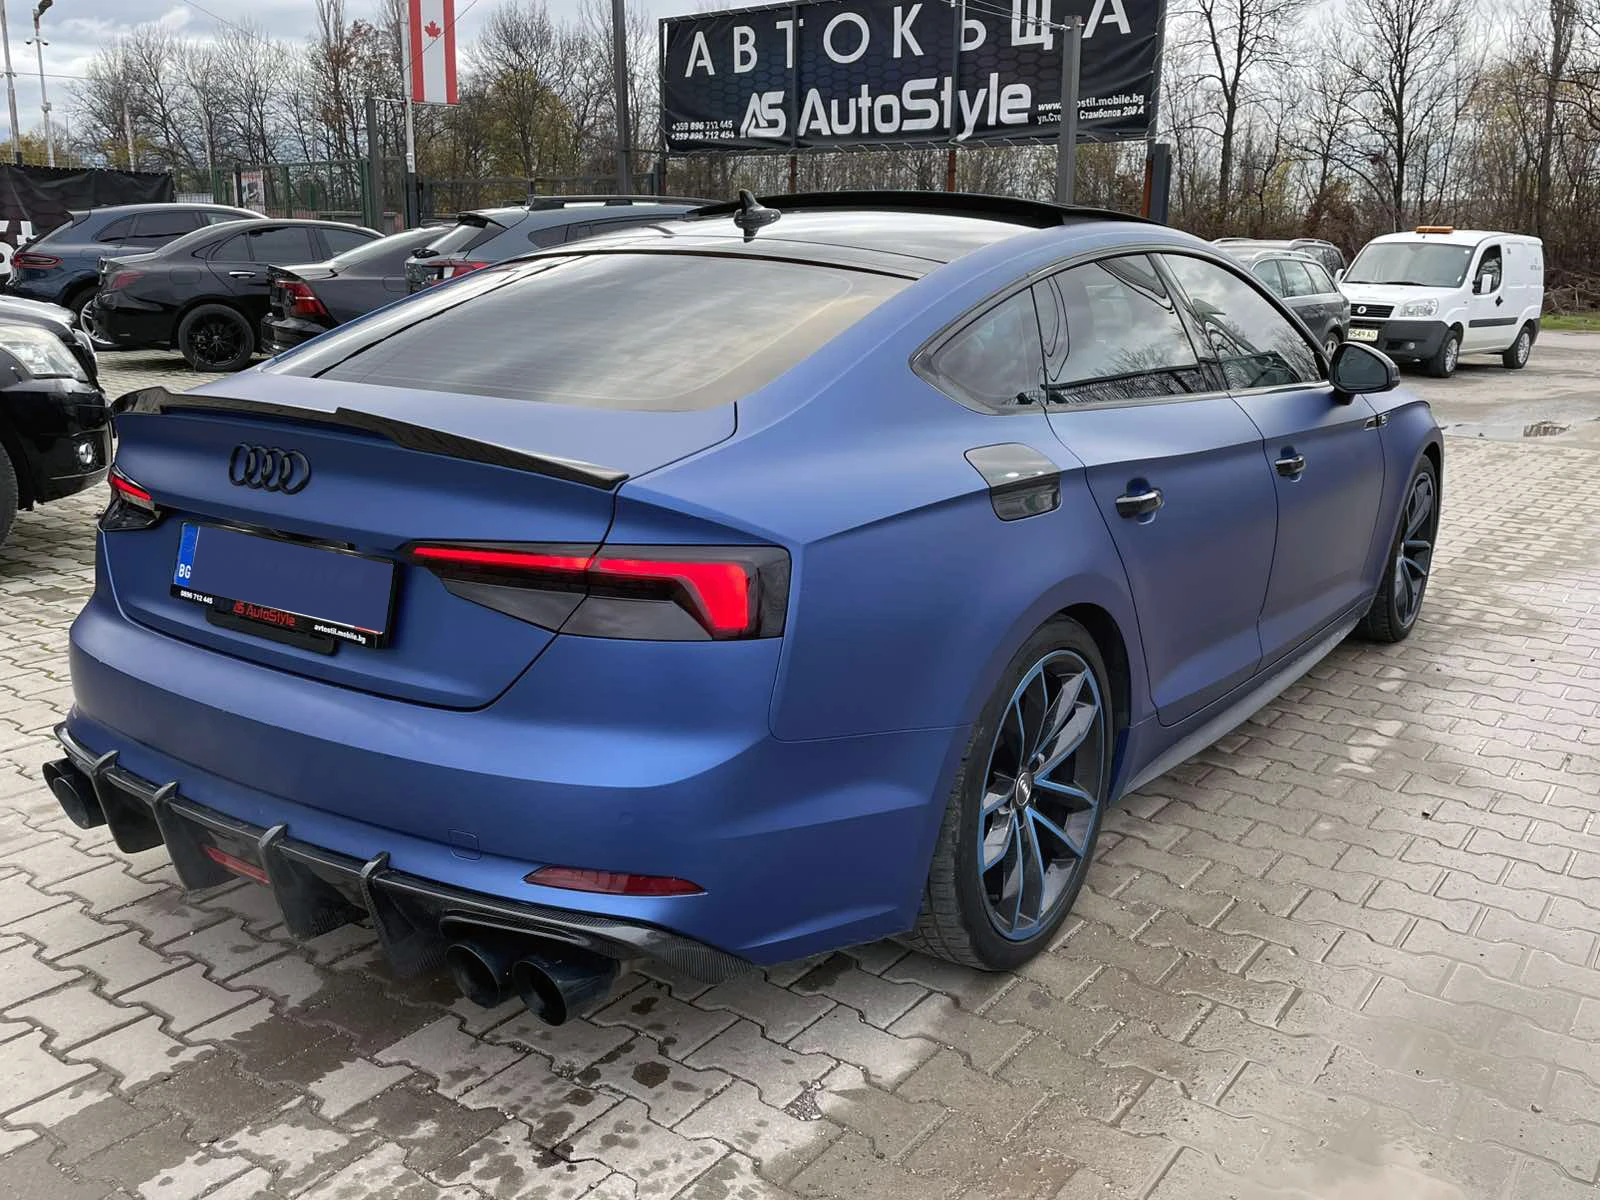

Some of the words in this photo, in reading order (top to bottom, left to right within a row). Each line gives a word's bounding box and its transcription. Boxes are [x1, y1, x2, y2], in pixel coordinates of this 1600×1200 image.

[797, 73, 1032, 141] AutoStyle
[672, 122, 689, 131] +359
[705, 121, 719, 129] 712
[671, 132, 689, 140] +359
[705, 131, 719, 139] 712
[179, 563, 191, 579] BG
[193, 593, 203, 602] 712
[246, 605, 296, 626] AutoStyle
[314, 624, 366, 645] avtostil.mobile.bg
